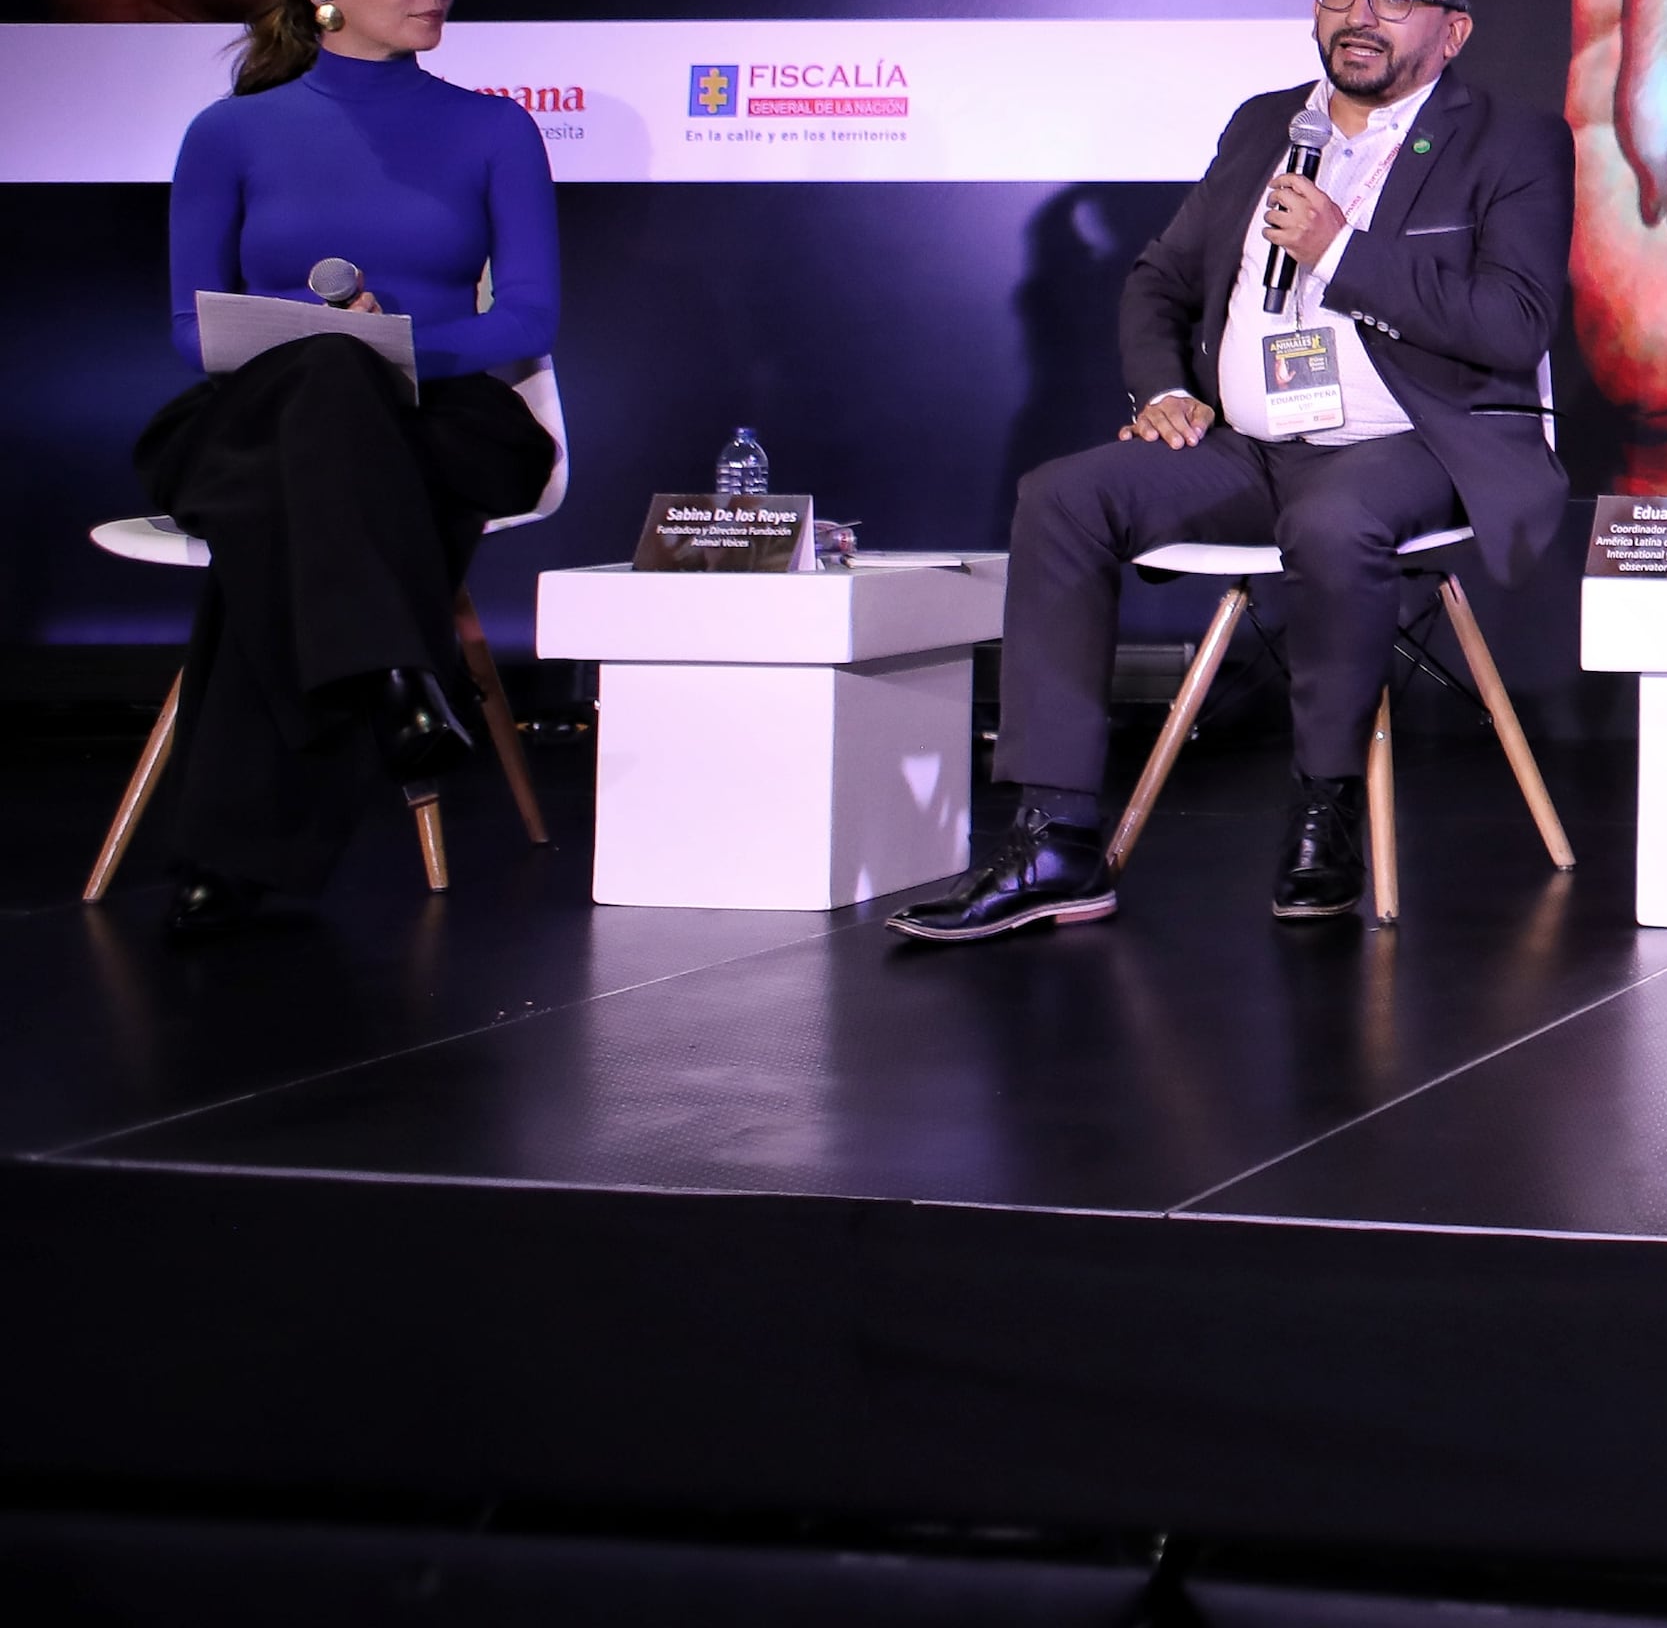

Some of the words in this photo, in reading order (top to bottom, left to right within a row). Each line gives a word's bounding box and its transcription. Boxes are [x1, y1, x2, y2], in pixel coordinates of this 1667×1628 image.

[750, 59, 908, 88] FISCALÍA
[751, 101, 813, 115] GENERAL
[817, 100, 833, 114] DE
[839, 100, 853, 114] LA
[685, 130, 702, 142] En
[708, 129, 722, 142] la
[727, 129, 762, 142] calle
[767, 132, 776, 143] y
[781, 132, 798, 141] en
[804, 129, 825, 141] los
[831, 129, 907, 141] territorios
[667, 507, 711, 522] Sabina
[714, 509, 733, 522] De
[735, 509, 755, 522] los
[758, 510, 797, 525] Reyes
[657, 526, 701, 535] Fundadora
[710, 527, 747, 535] Directora
[749, 527, 791, 536] Fundación
[1610, 524, 1667, 534] Coordinador
[691, 538, 721, 547] Animal
[723, 538, 749, 547] Voices
[1596, 537, 1632, 547] América
[1635, 538, 1662, 547] Latina
[1607, 551, 1664, 560] International
